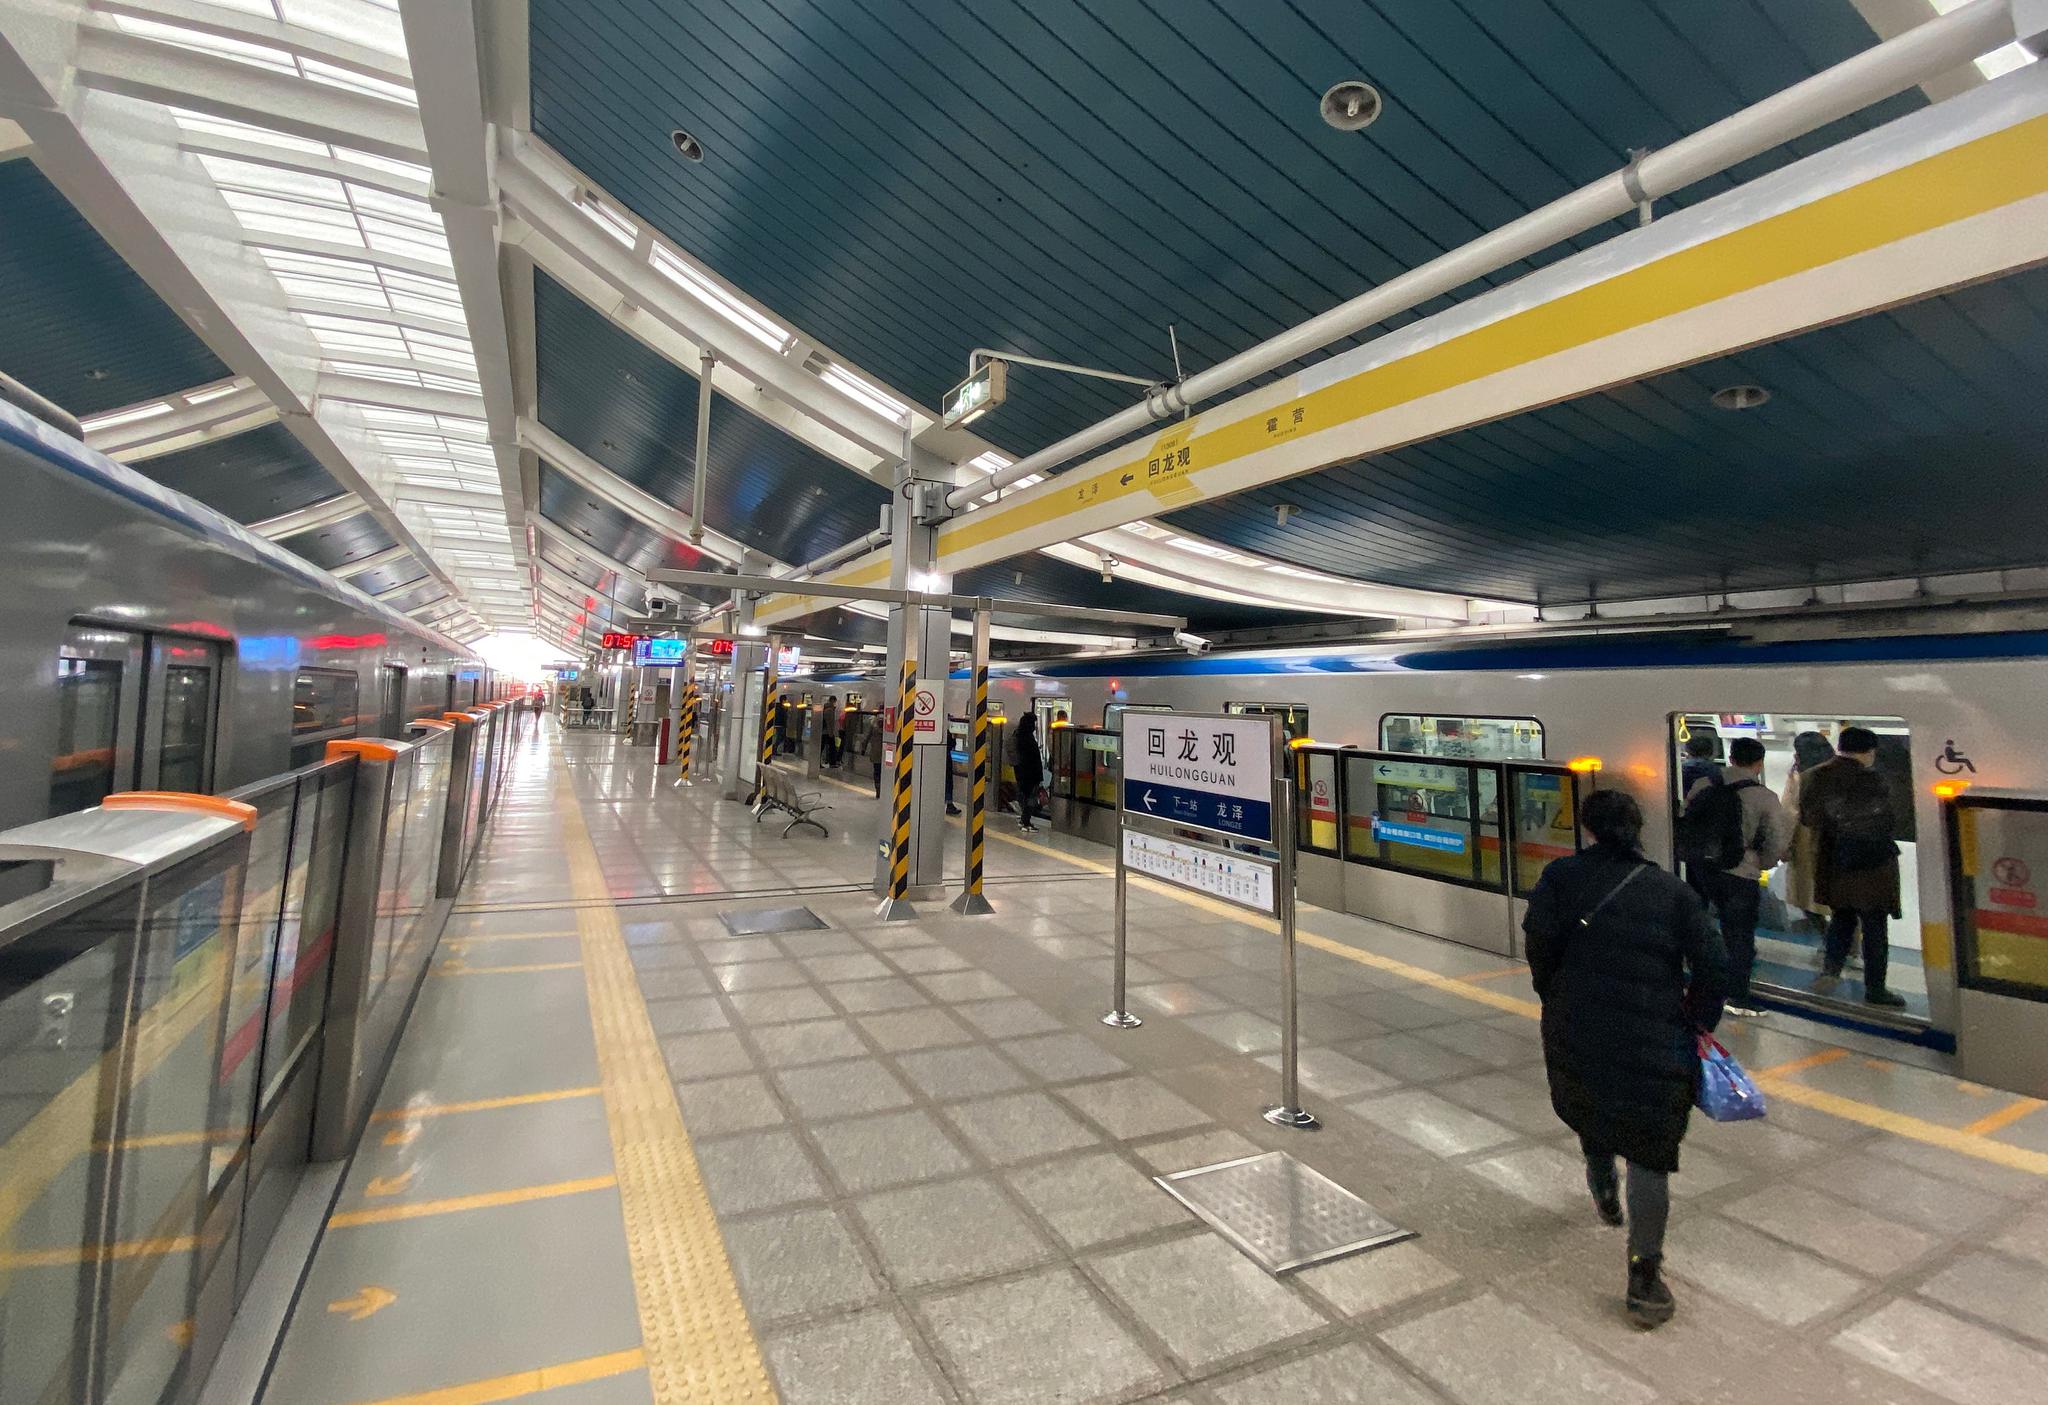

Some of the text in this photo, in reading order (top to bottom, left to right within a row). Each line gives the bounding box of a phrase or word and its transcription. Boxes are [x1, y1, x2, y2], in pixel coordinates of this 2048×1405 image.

[1148, 446, 1191, 478] 回龙观
[1147, 727, 1237, 767] 回龙观
[1150, 763, 1236, 787] HUILONGGUAN
[1173, 795, 1244, 821] 下一站 龙泽
[1218, 818, 1243, 830] LONGZE
